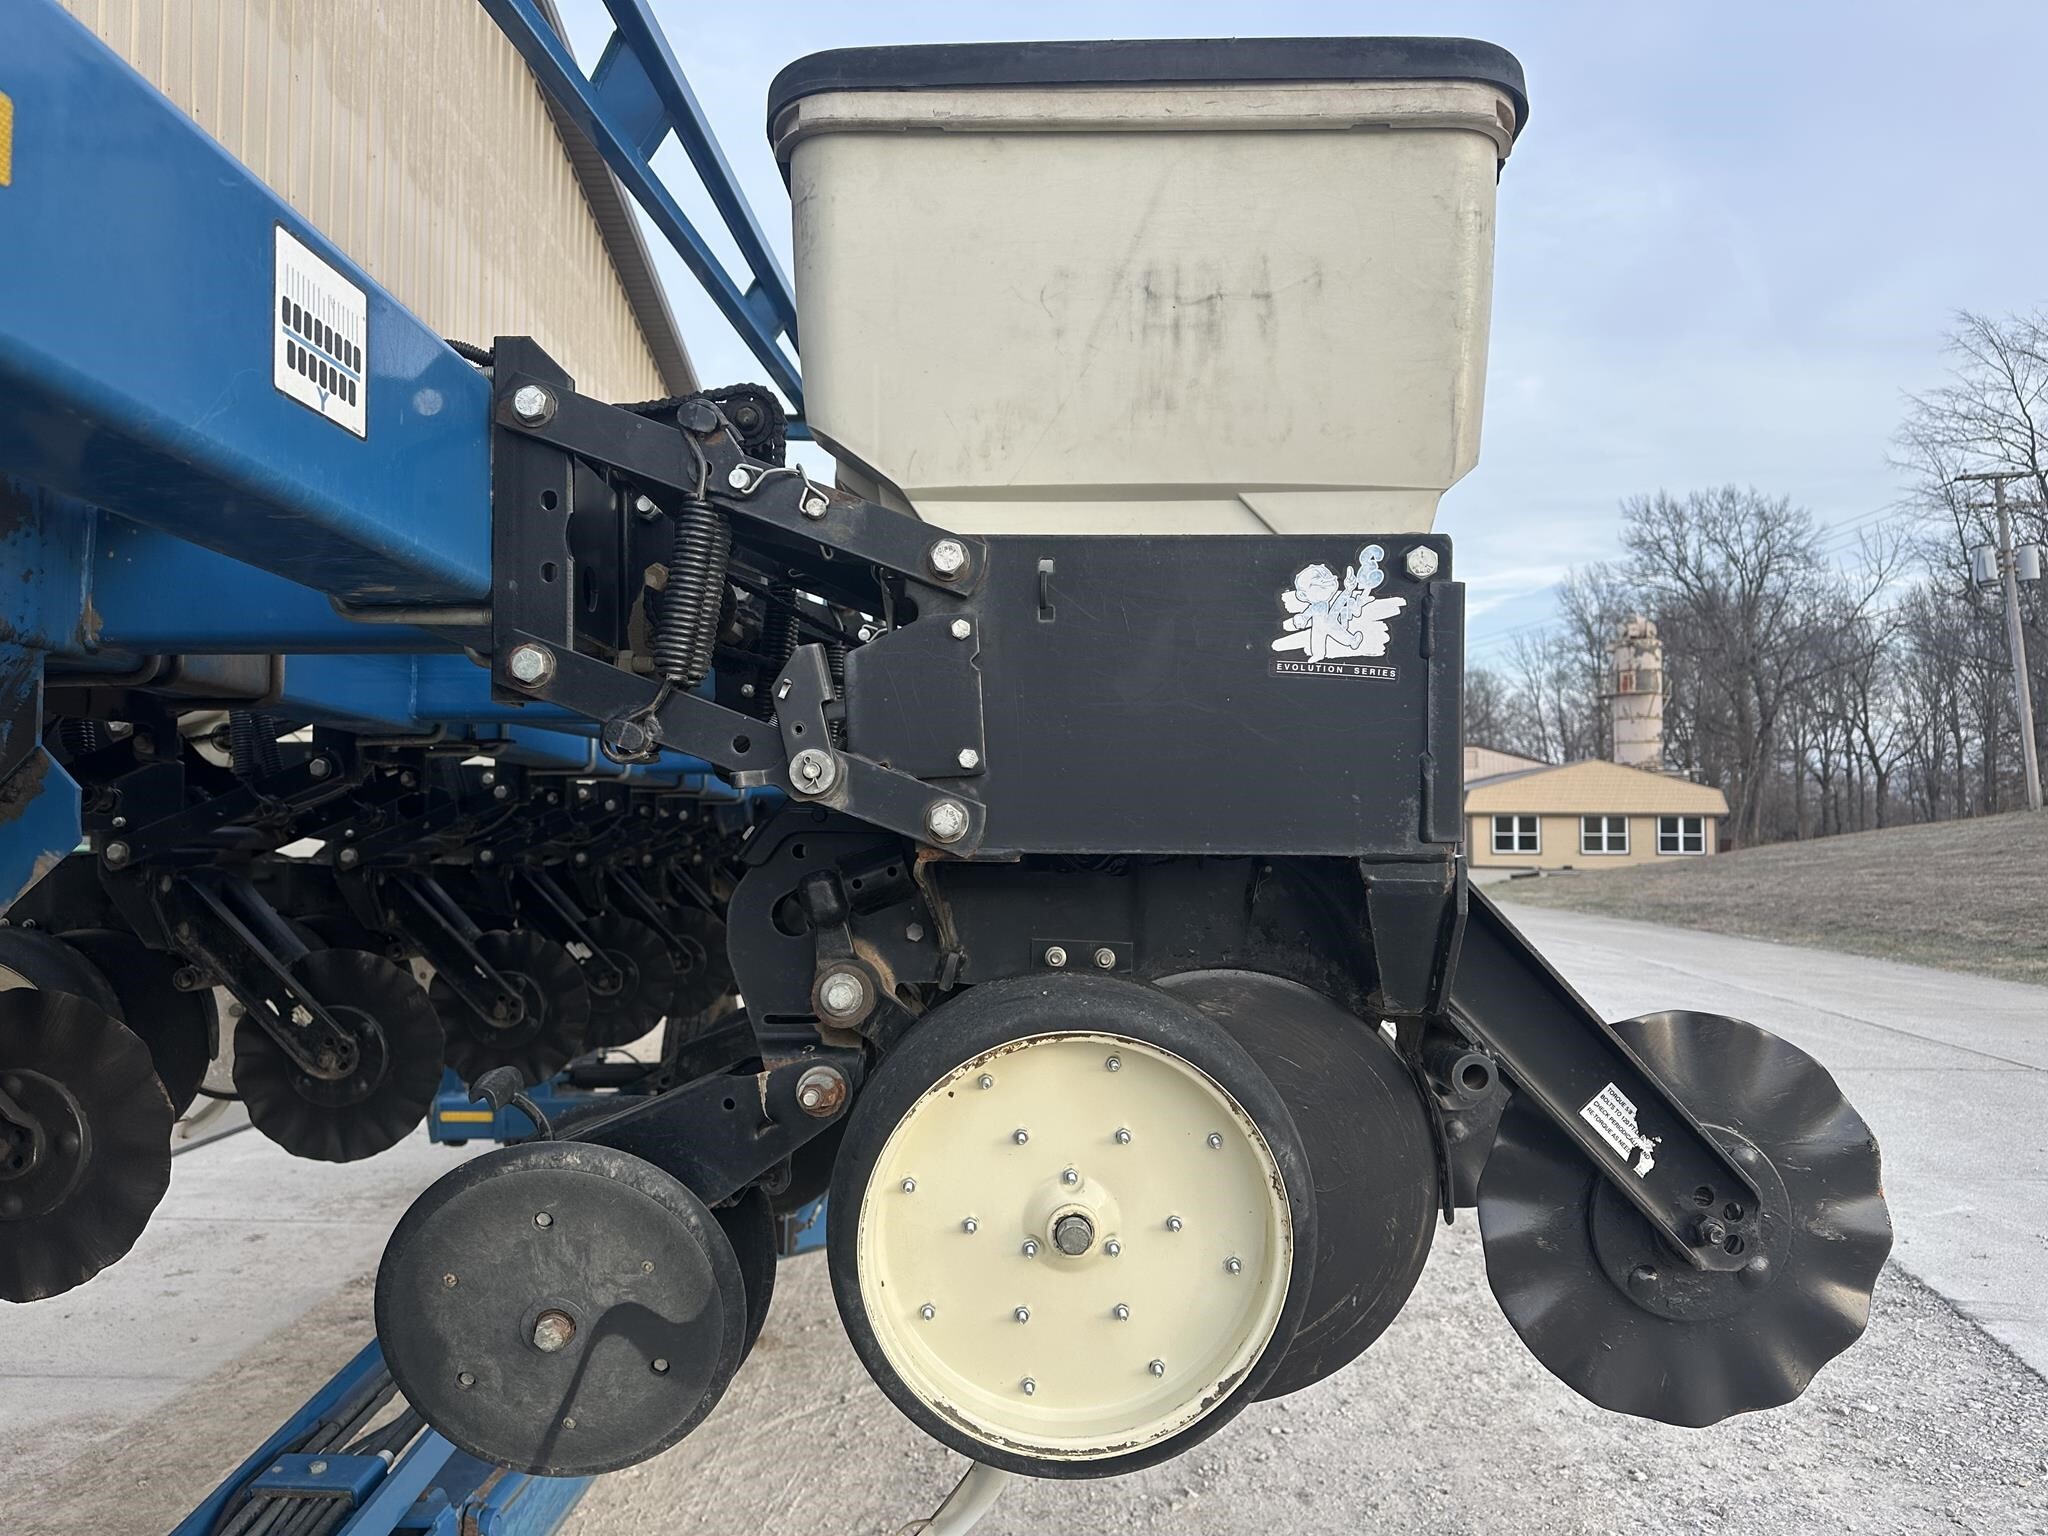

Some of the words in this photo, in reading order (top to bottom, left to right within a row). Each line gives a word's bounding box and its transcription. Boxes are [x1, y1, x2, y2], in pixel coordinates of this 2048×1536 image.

[1276, 663, 1343, 674] EVOLUTION
[1354, 667, 1396, 677] SERIES
[1600, 1094, 1615, 1110] BOLTS
[1614, 1108, 1621, 1117] TO
[1607, 1087, 1628, 1107] TORQUE
[1587, 1107, 1613, 1134] RE-TORQUE
[1611, 1132, 1619, 1141] AS
[1593, 1100, 1610, 1118] CHECK
[1609, 1116, 1639, 1148] PERIODICALL
